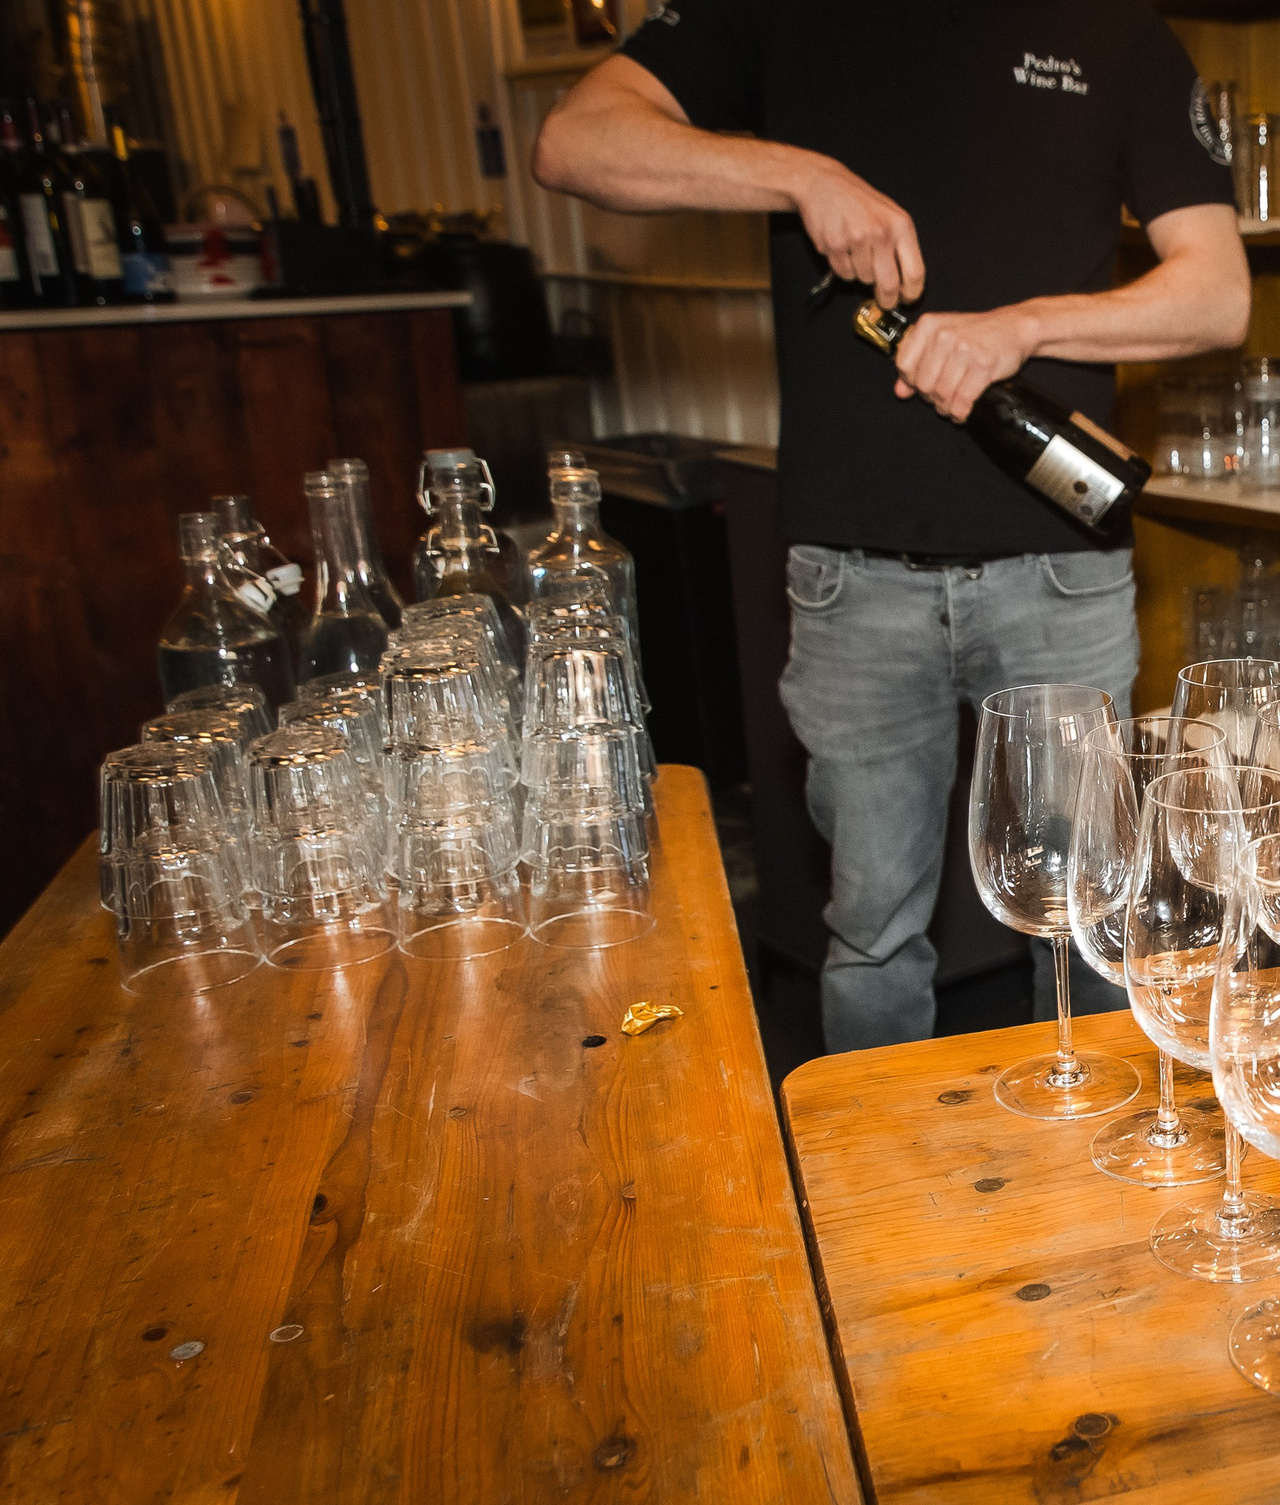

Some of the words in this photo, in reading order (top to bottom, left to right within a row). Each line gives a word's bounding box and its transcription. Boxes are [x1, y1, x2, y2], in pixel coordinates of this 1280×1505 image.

[1023, 53, 1082, 76] Pedro's
[1014, 67, 1057, 89] Wine
[1062, 75, 1088, 95] Bar
